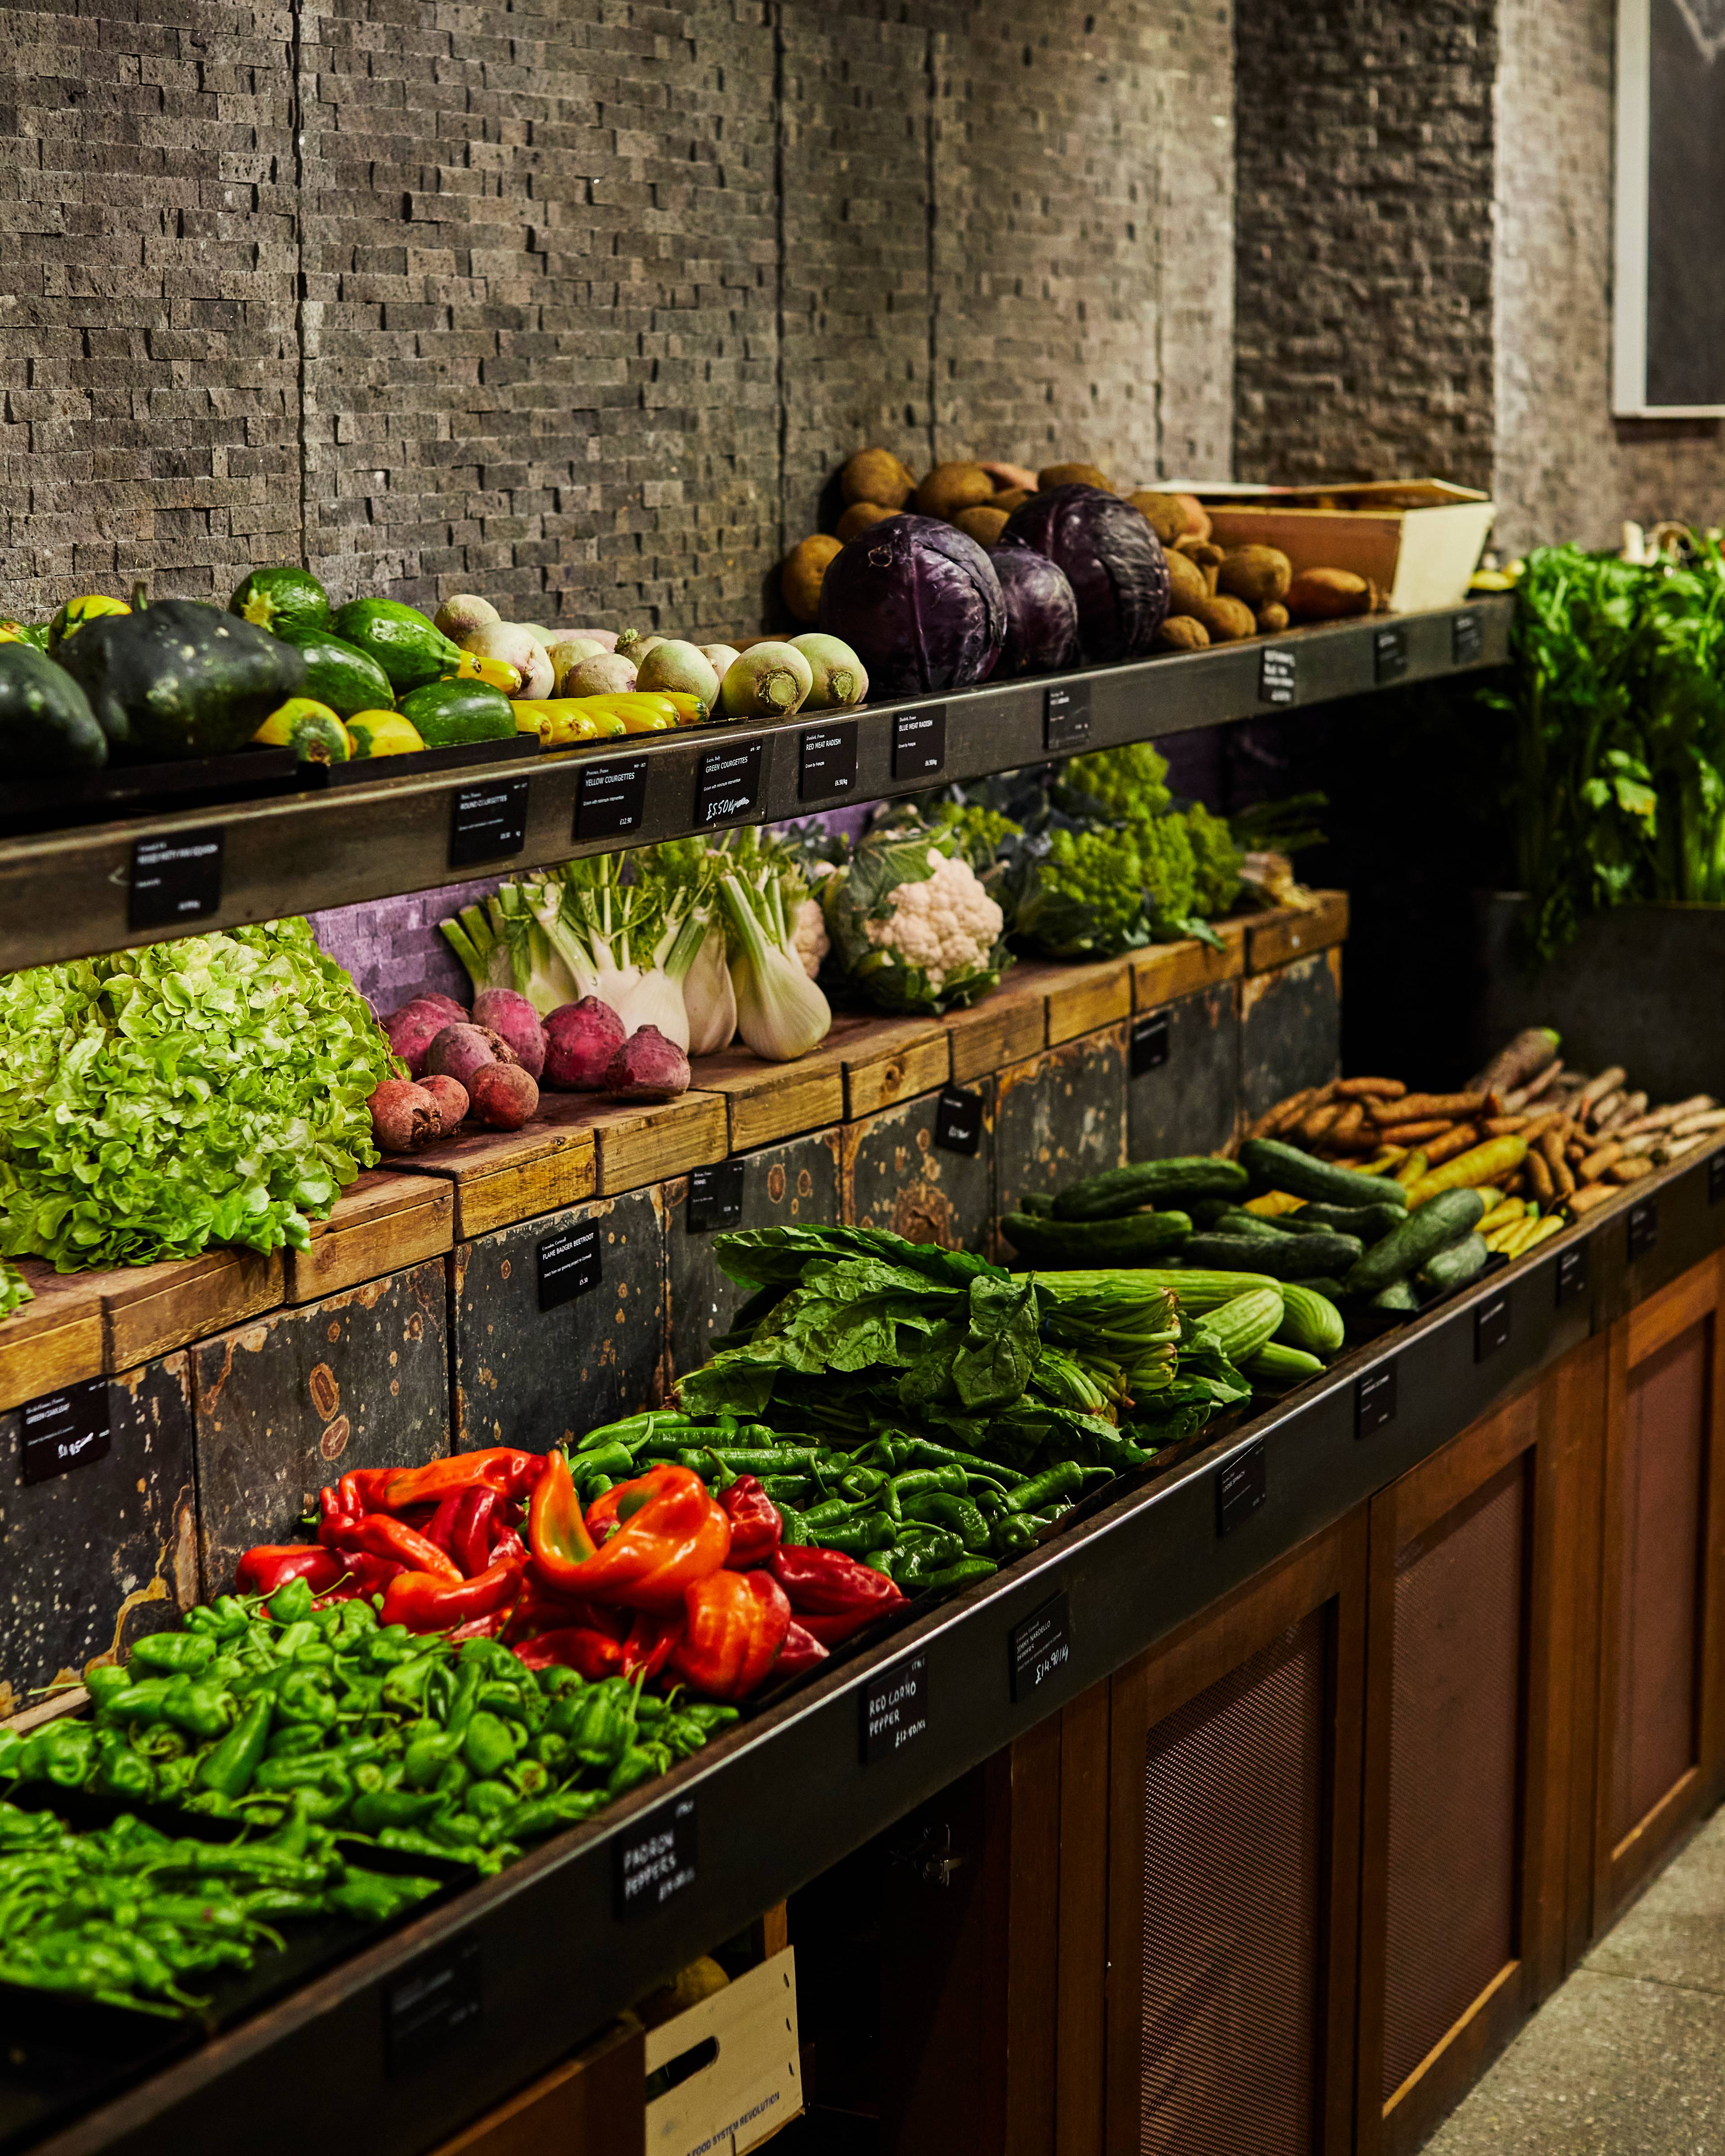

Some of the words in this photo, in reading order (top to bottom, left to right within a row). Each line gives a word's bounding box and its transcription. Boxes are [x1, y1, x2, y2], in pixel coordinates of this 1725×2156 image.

[909, 722, 919, 730] MEAT
[919, 720, 933, 728] RADISH
[815, 741, 826, 749] MEAT
[826, 738, 841, 747] RADISH
[706, 764, 720, 773] GREEN
[721, 756, 748, 769] COURGETTES
[585, 777, 604, 786] YELLOW
[605, 772, 635, 784] COURGETTES
[543, 1250, 556, 1260] FLAME
[557, 1242, 573, 1254] BADGER
[573, 1233, 594, 1247] BEETROOT
[1017, 1639, 1029, 1654] JIMMY
[1030, 1621, 1051, 1643] NARDELLO
[1017, 1644, 1034, 1662] PEPPERS
[870, 1694, 886, 1717] RED
[889, 1680, 916, 1706] CORNO
[870, 1709, 900, 1737] PEPPER
[712, 2120, 739, 2146] SYSTEM
[740, 2091, 779, 2126] REVOLUTION
